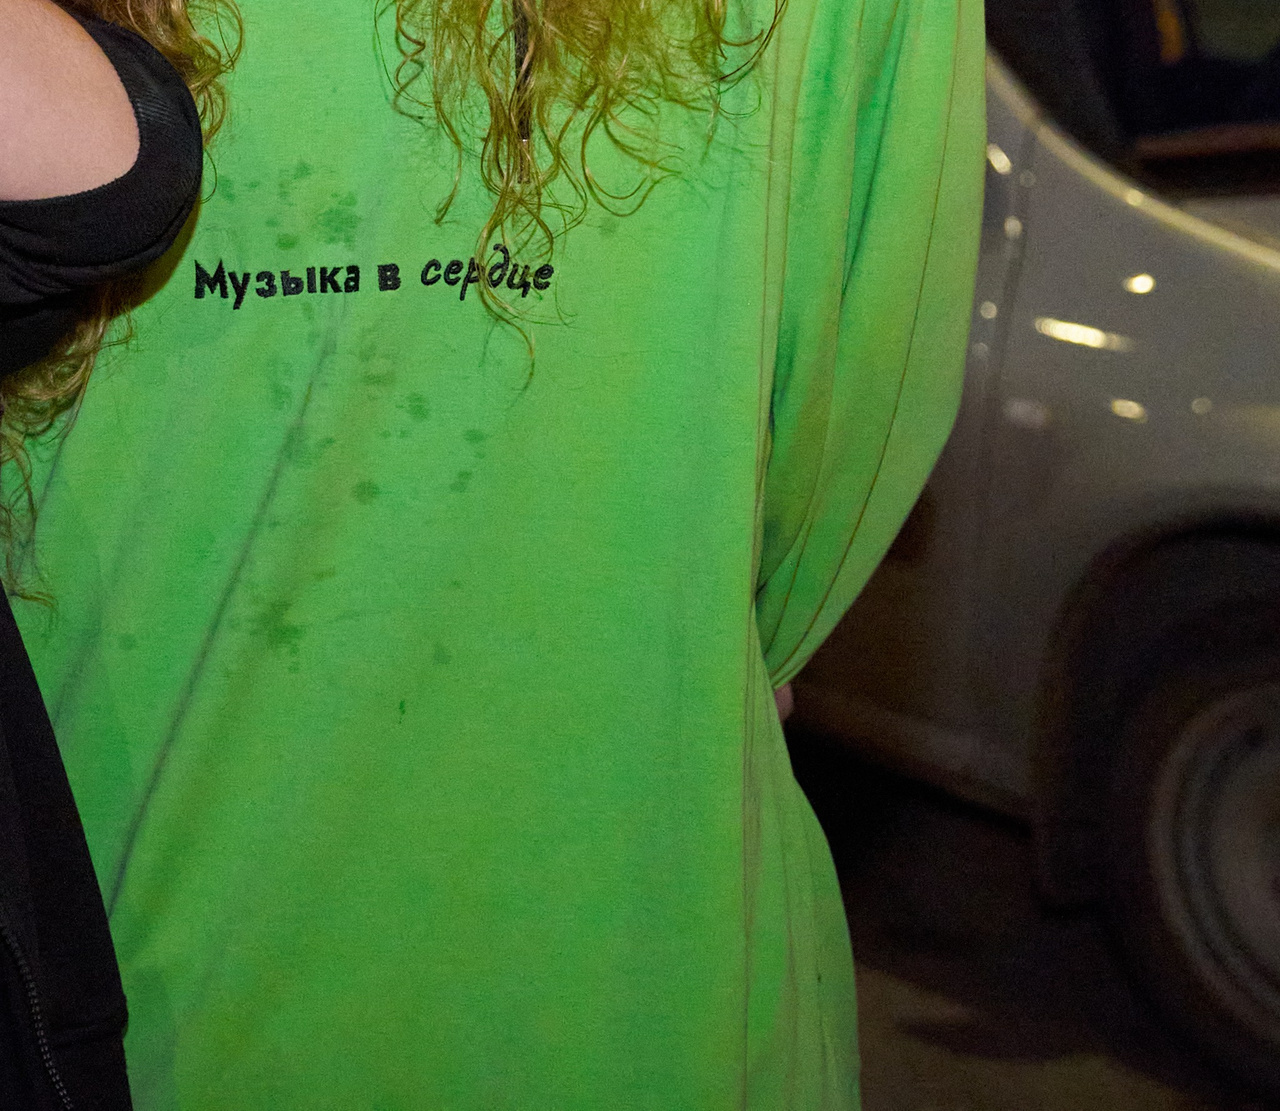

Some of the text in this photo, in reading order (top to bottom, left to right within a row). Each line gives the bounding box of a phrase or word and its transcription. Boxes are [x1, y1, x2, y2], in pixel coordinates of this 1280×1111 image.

[194, 243, 555, 310] Музыка в сердце
